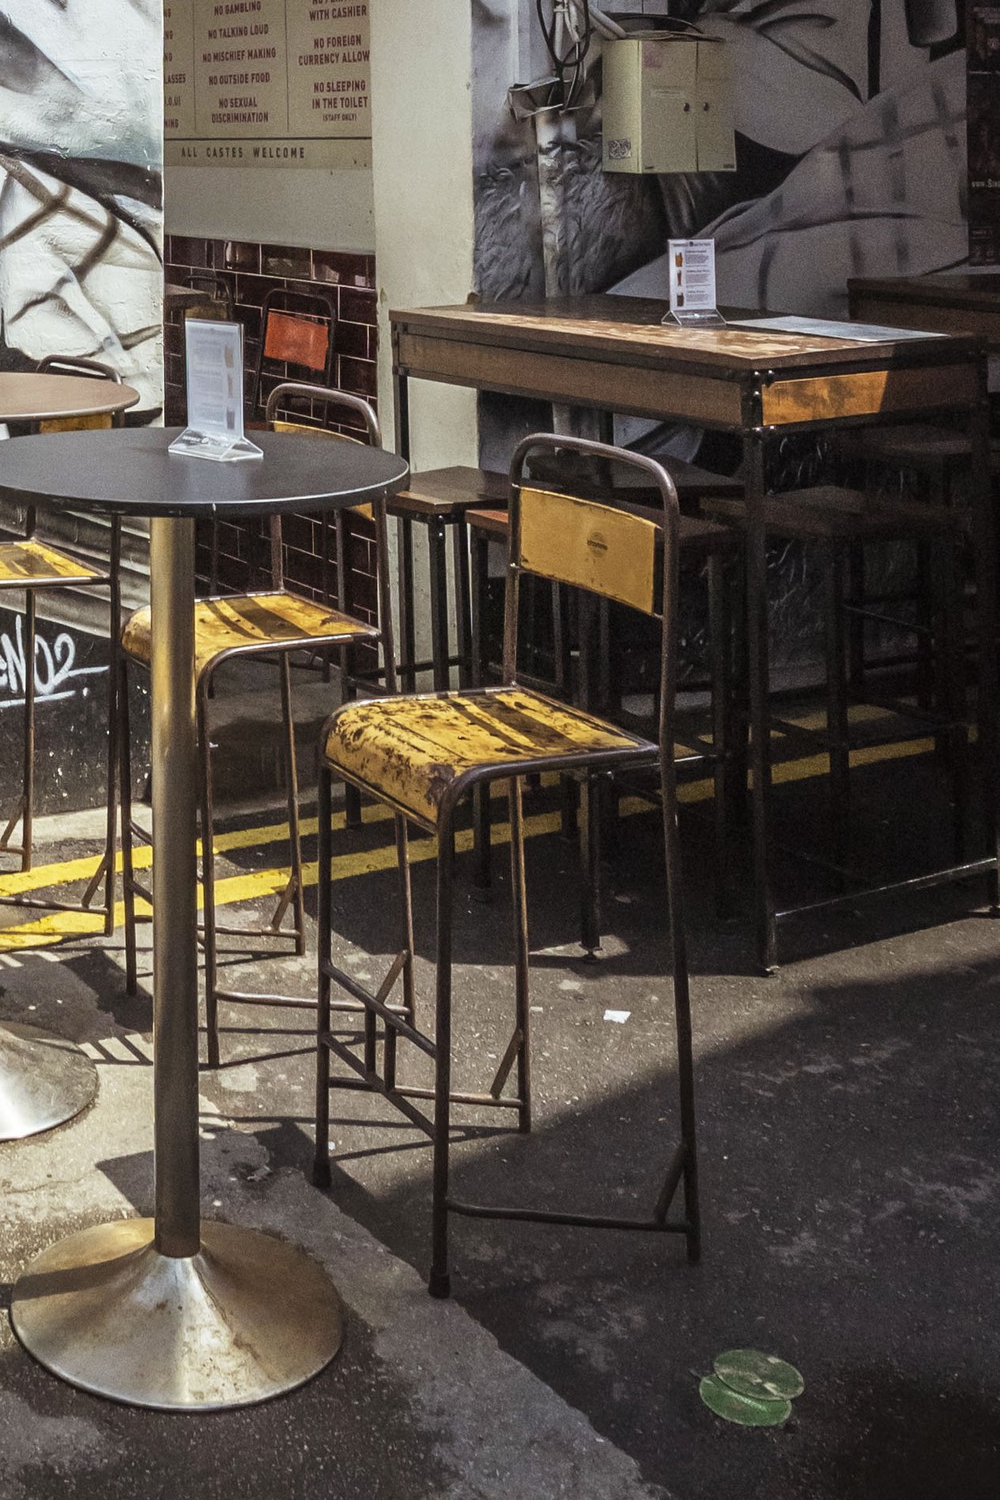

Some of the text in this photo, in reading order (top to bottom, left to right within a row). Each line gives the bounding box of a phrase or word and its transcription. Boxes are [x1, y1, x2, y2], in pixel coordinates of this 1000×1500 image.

[214, 1, 262, 16] NO GAMBLING
[309, 4, 367, 21] WITH CASHIER
[208, 24, 269, 40] NO TALKING LOUD
[314, 34, 362, 49] NO FOREIGN
[202, 47, 276, 63] NO MISCHIEF MAKING
[298, 50, 370, 66] CURRENCY ALLOW
[209, 72, 271, 85] NO OUTSIDE FOOD
[314, 80, 366, 93] NO SLEEPING
[219, 97, 258, 108] NO SEXUAL
[312, 96, 368, 109] IN THE TOILET
[211, 111, 269, 123] DISCRIMINATION
[181, 146, 305, 159] ALL CASTES WELCOME
